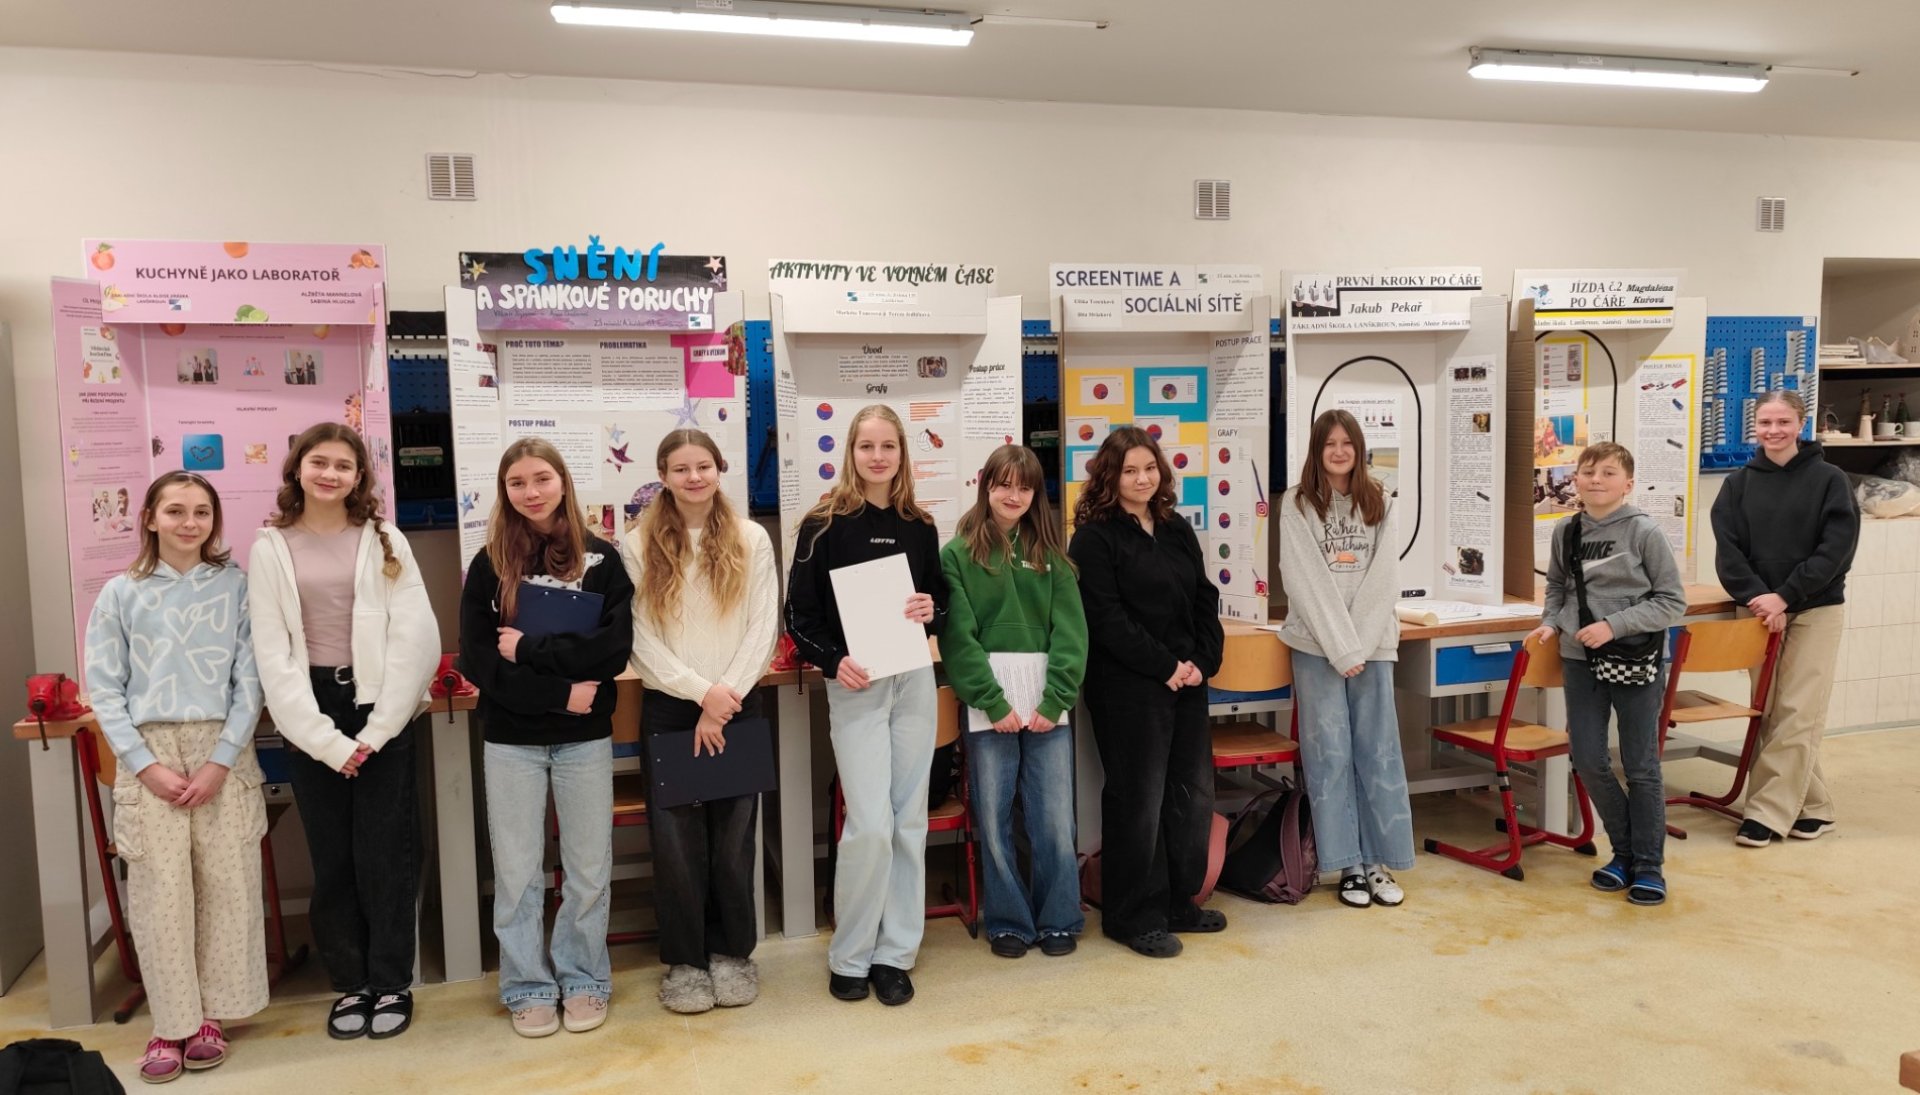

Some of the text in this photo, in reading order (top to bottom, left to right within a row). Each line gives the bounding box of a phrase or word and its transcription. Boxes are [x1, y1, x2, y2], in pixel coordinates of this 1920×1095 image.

[523, 234, 665, 284] SNĚNÍ
[136, 265, 341, 282] KUCHYNĚ JAKO LABORATOŘ
[769, 261, 995, 287] AKTIVITY VE VOLNÉM ČASE
[1169, 271, 1181, 286] A
[1336, 273, 1482, 286] PRVNÍ KROKY PO ČÁŘE
[1569, 280, 1606, 293] JÍZDA
[1626, 284, 1674, 294] Magdaléna
[477, 281, 714, 313] A SPÁNKOVÉ PORUCHY
[1125, 292, 1243, 313] SOCIÁLNÍ SÍTĚ
[1570, 294, 1626, 307] PO ČÁŘE
[1632, 295, 1665, 303] Kuřová
[1348, 301, 1423, 314] Jakub Pekař
[1292, 322, 1328, 330] ZÁKLADNÍ
[1329, 321, 1352, 329] ŠKOLA
[505, 339, 523, 348] PROČ
[543, 340, 564, 348] TÉMA?
[600, 341, 647, 349] PROBLEMATIKA
[1215, 337, 1240, 348] POSTUP
[862, 344, 883, 354] Úvod
[968, 363, 1006, 373] Postup práce
[866, 383, 888, 394] Grafy
[508, 418, 556, 427] POSTUP PRÁCE
[1217, 428, 1239, 437] GRAFY
[1580, 541, 1616, 560] NIKE
